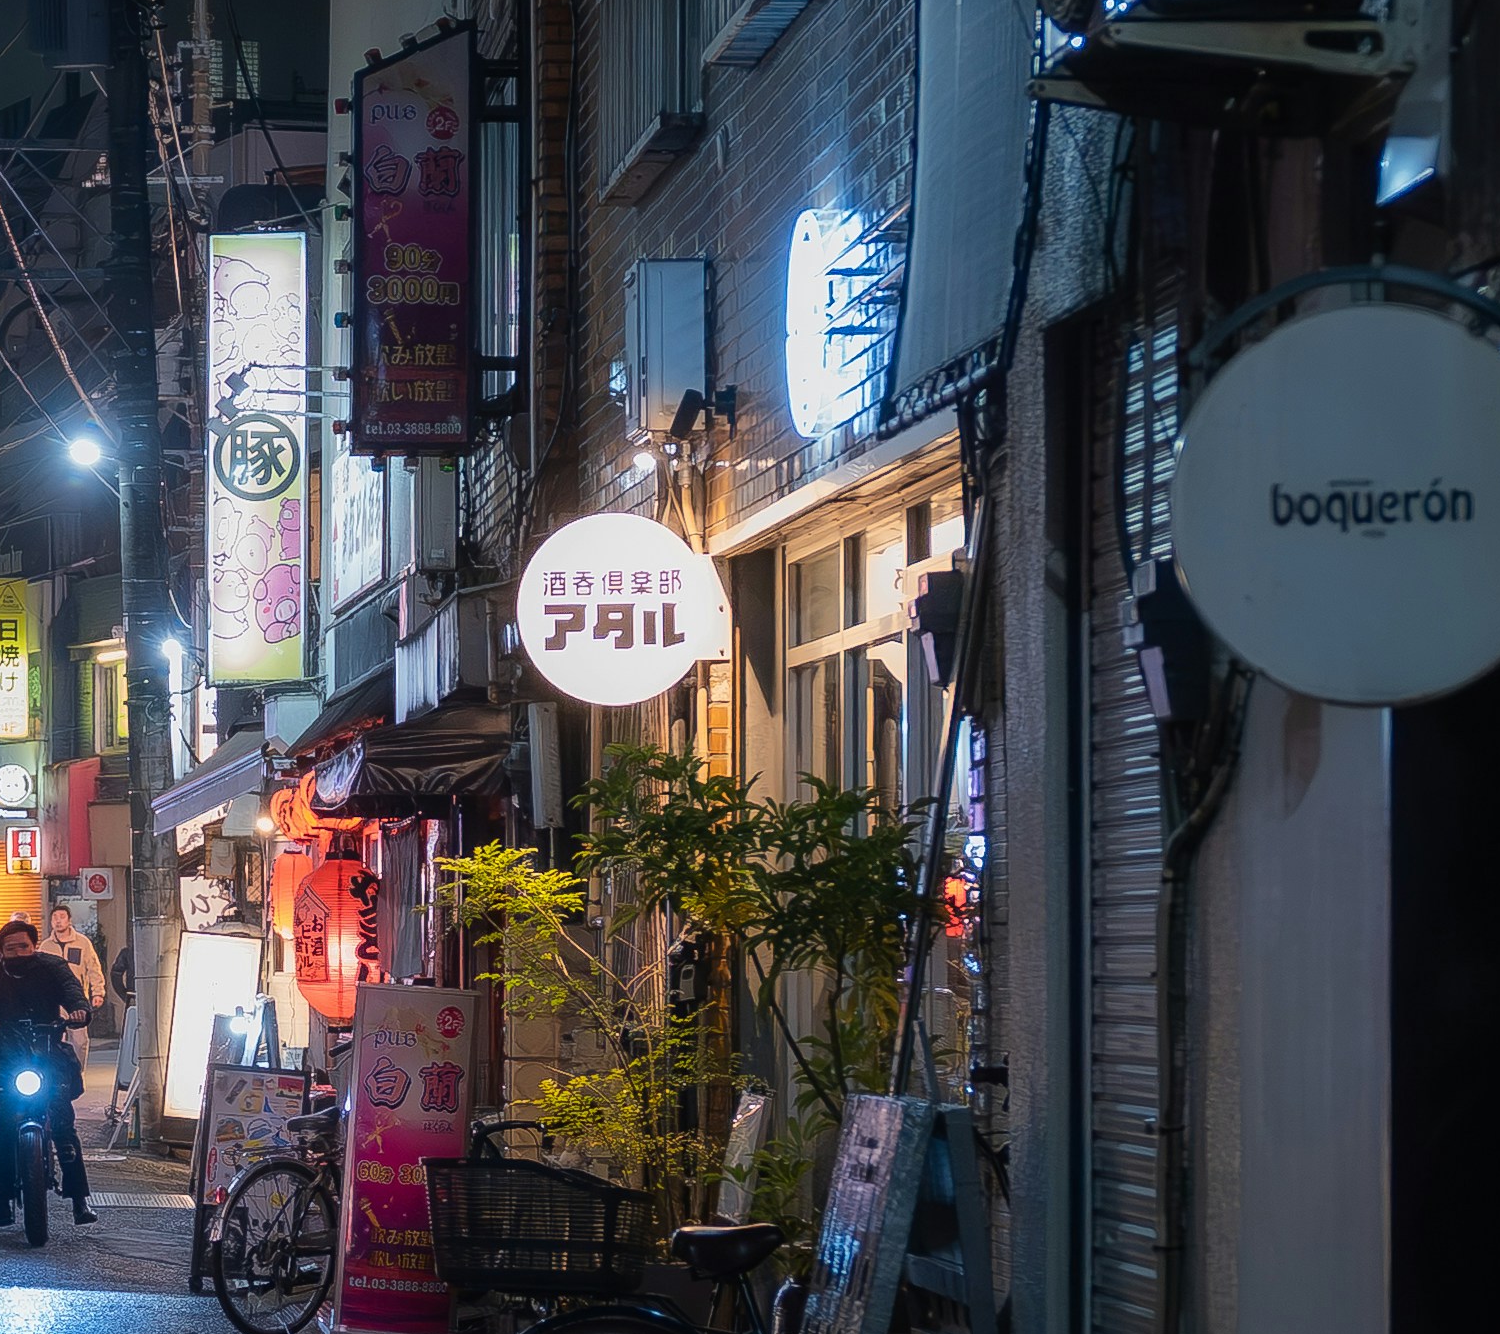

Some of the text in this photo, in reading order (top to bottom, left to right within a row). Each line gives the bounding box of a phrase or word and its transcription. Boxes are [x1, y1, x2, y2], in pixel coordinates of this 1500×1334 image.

[364, 145, 466, 197] 白蘭
[384, 243, 443, 273] 90分
[366, 275, 460, 305] 3000円
[230, 431, 287, 485] 豚
[1271, 478, 1475, 533] boquerón
[544, 603, 685, 650] アタル
[365, 1055, 464, 1113] 白蘭
[358, 1161, 395, 1184] 60分
